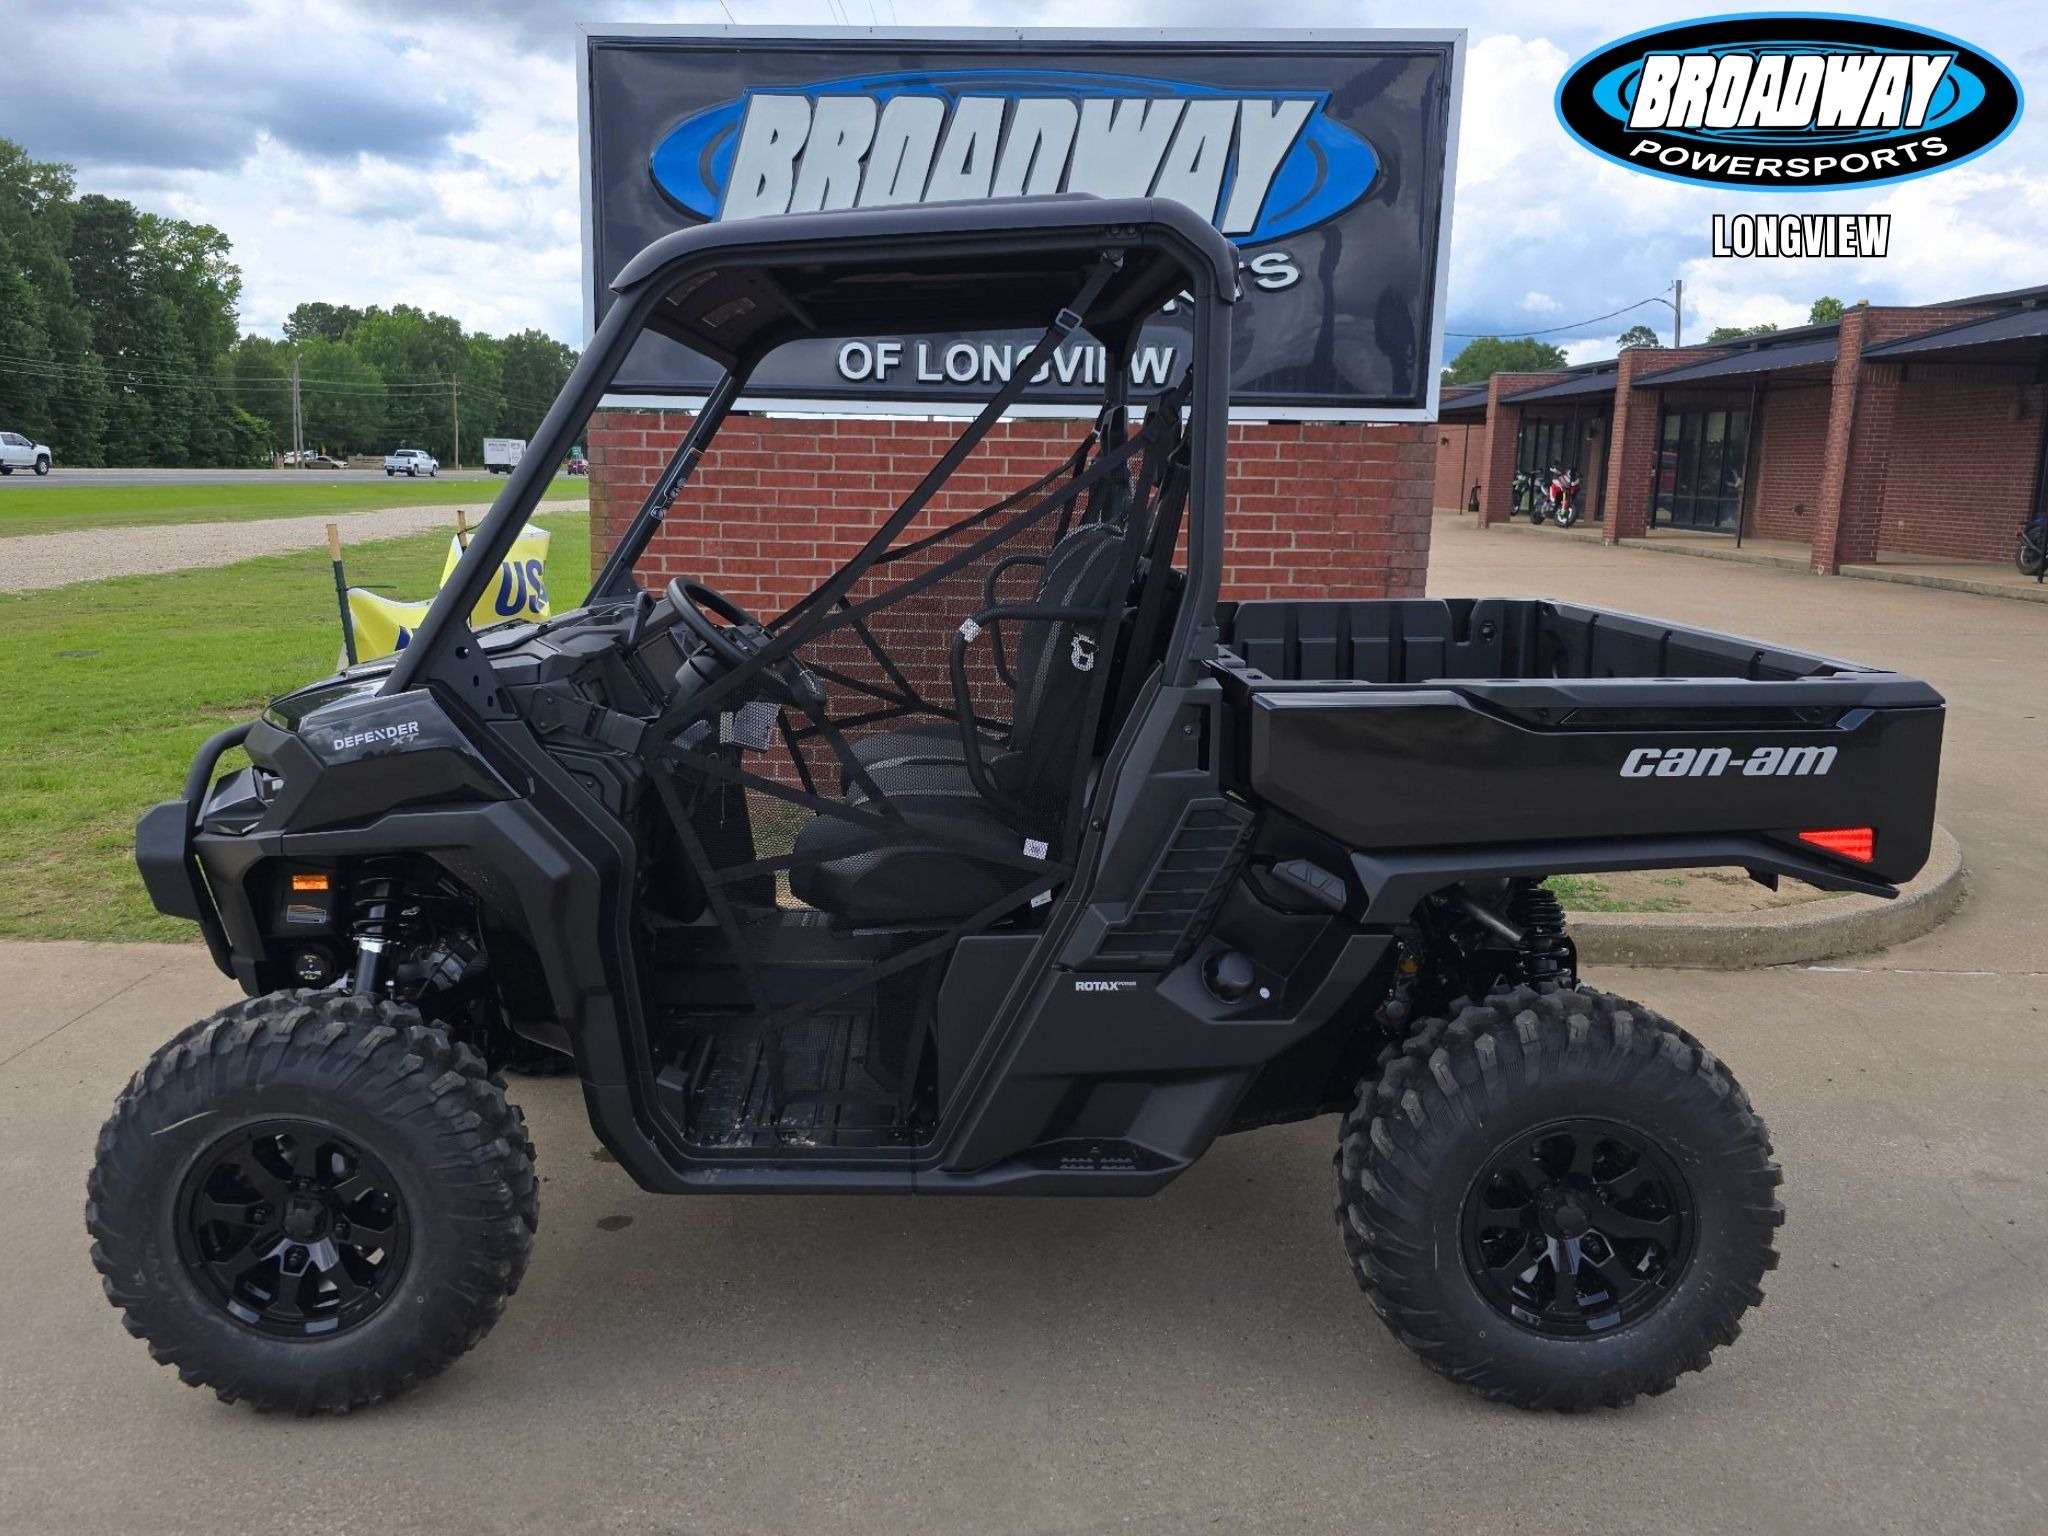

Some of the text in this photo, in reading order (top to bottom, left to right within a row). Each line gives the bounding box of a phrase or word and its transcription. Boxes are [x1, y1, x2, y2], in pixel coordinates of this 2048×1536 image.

[720, 95, 1318, 234] BROADWAY
[838, 342, 1174, 385] OF LONGVIW
[333, 721, 420, 751] DEFENDER
[391, 732, 420, 747] XT
[1619, 746, 1839, 778] can-am
[1075, 981, 1119, 992] ROTAX
